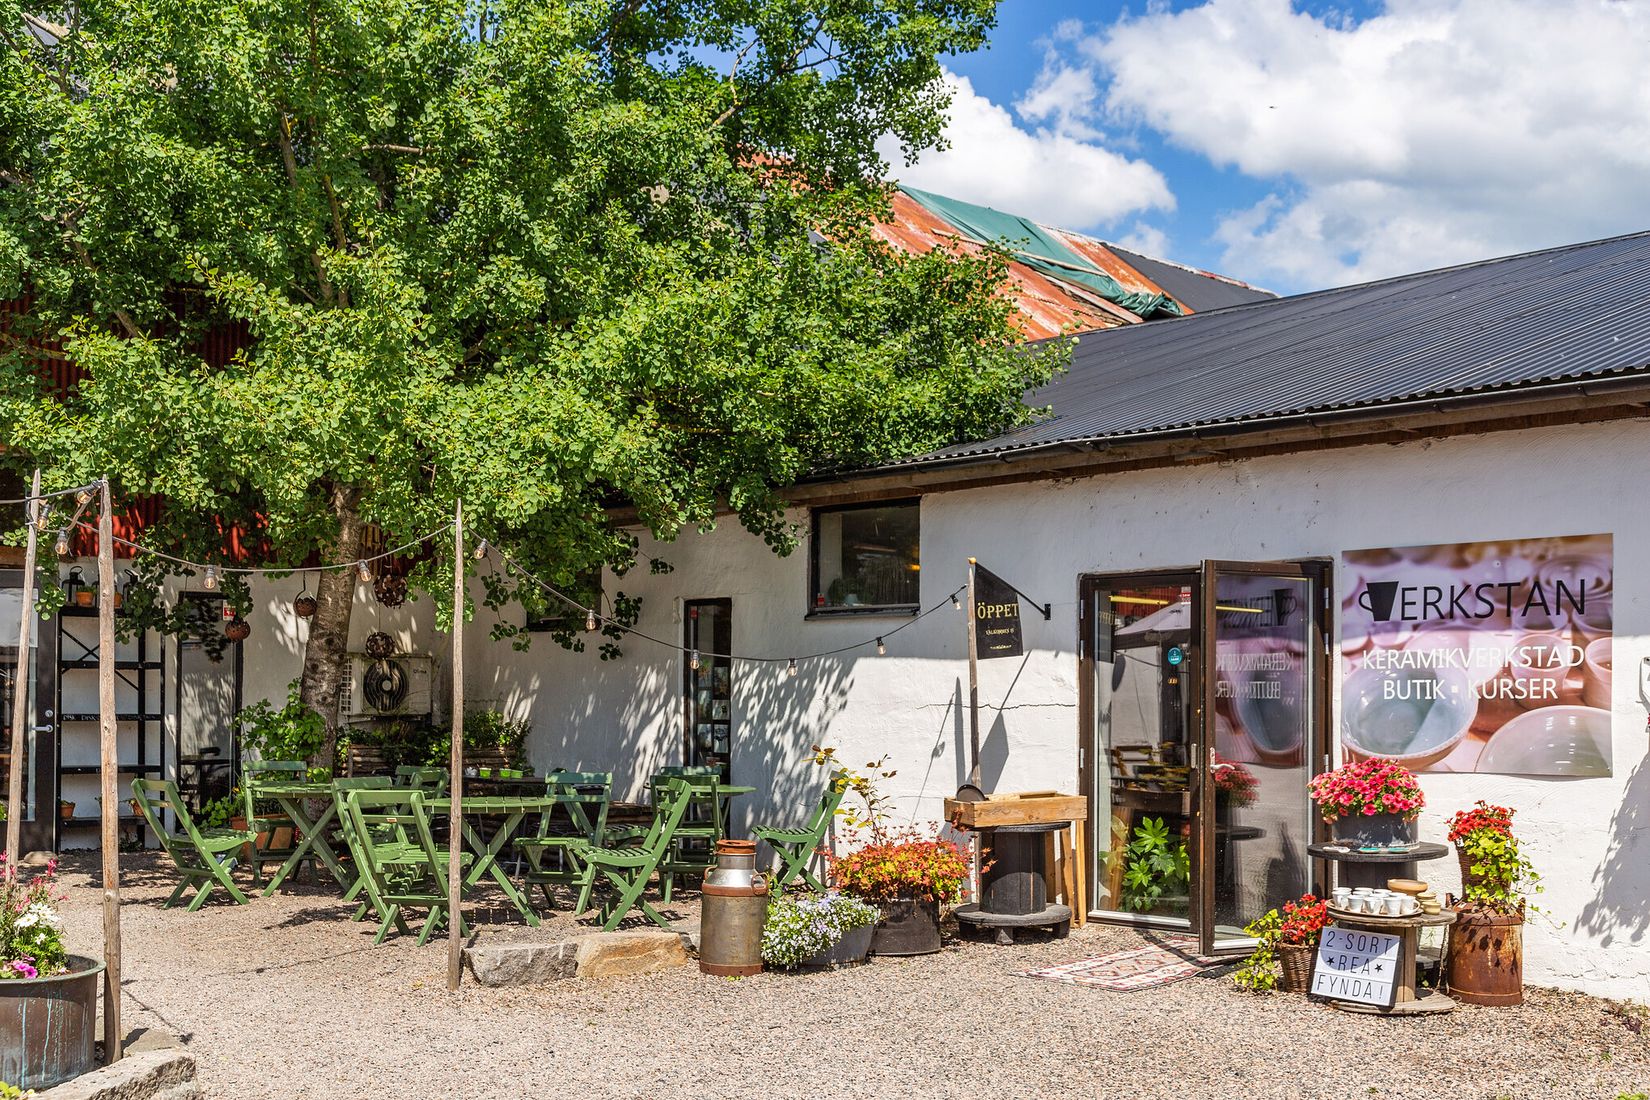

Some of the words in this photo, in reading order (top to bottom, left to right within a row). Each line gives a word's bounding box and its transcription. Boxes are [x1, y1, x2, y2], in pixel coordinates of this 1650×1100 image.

[977, 602, 1018, 619] ÖPPET
[1362, 645, 1585, 670] KERAMIKVERKSTAD
[1383, 679, 1446, 700] BUTIK
[1468, 678, 1559, 700] KURSER
[1326, 930, 1393, 955] 2-SORT
[1316, 974, 1384, 999] FYNDA!
